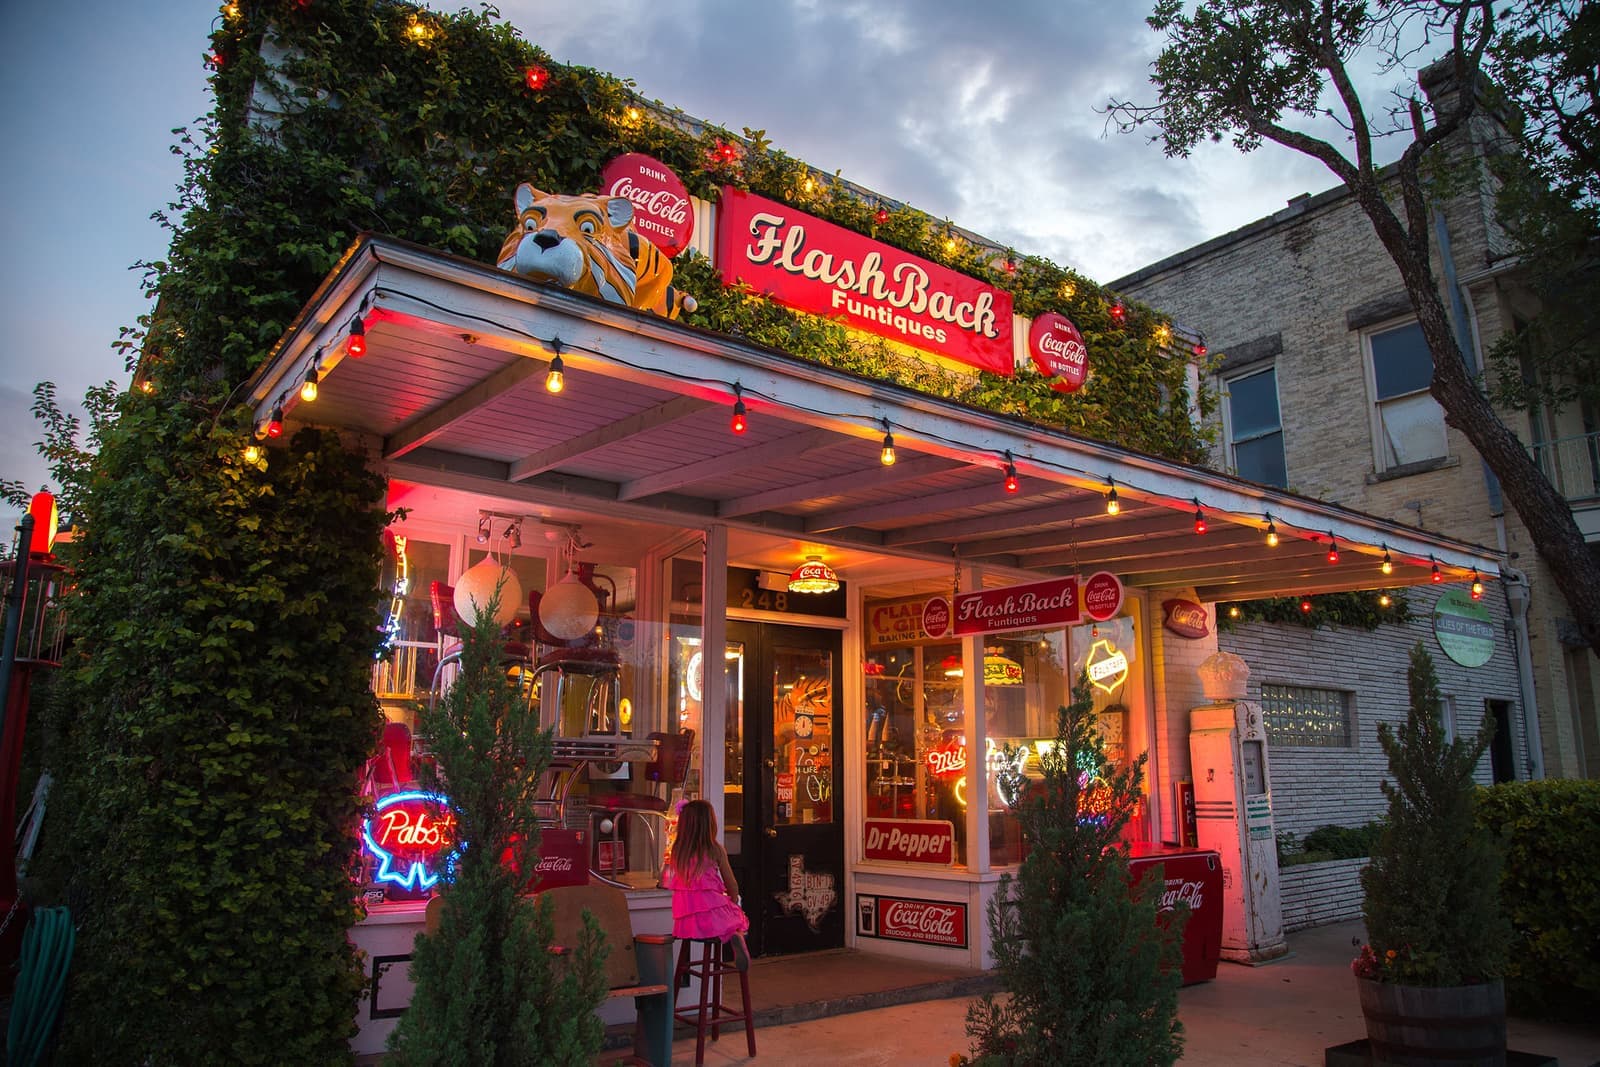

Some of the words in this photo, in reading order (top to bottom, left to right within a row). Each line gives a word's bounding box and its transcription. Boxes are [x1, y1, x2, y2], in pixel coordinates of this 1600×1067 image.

[640, 166, 667, 183] DRINK
[639, 218, 675, 238] BOTTLES
[832, 288, 947, 344] Funtiques
[1054, 321, 1072, 334] DRINK
[1050, 360, 1058, 369] IN
[1058, 362, 1080, 376] BOTTLES
[741, 588, 789, 611] 248
[987, 615, 1038, 628] Funtiques
[878, 631, 915, 643] BAKING
[777, 787, 792, 800] PUSH
[866, 827, 889, 850] Dr
[887, 828, 951, 858] Pepper
[885, 902, 957, 935] Coca-Cola
[885, 928, 912, 937] DELICIOUS
[925, 933, 957, 942] REFRESHING
